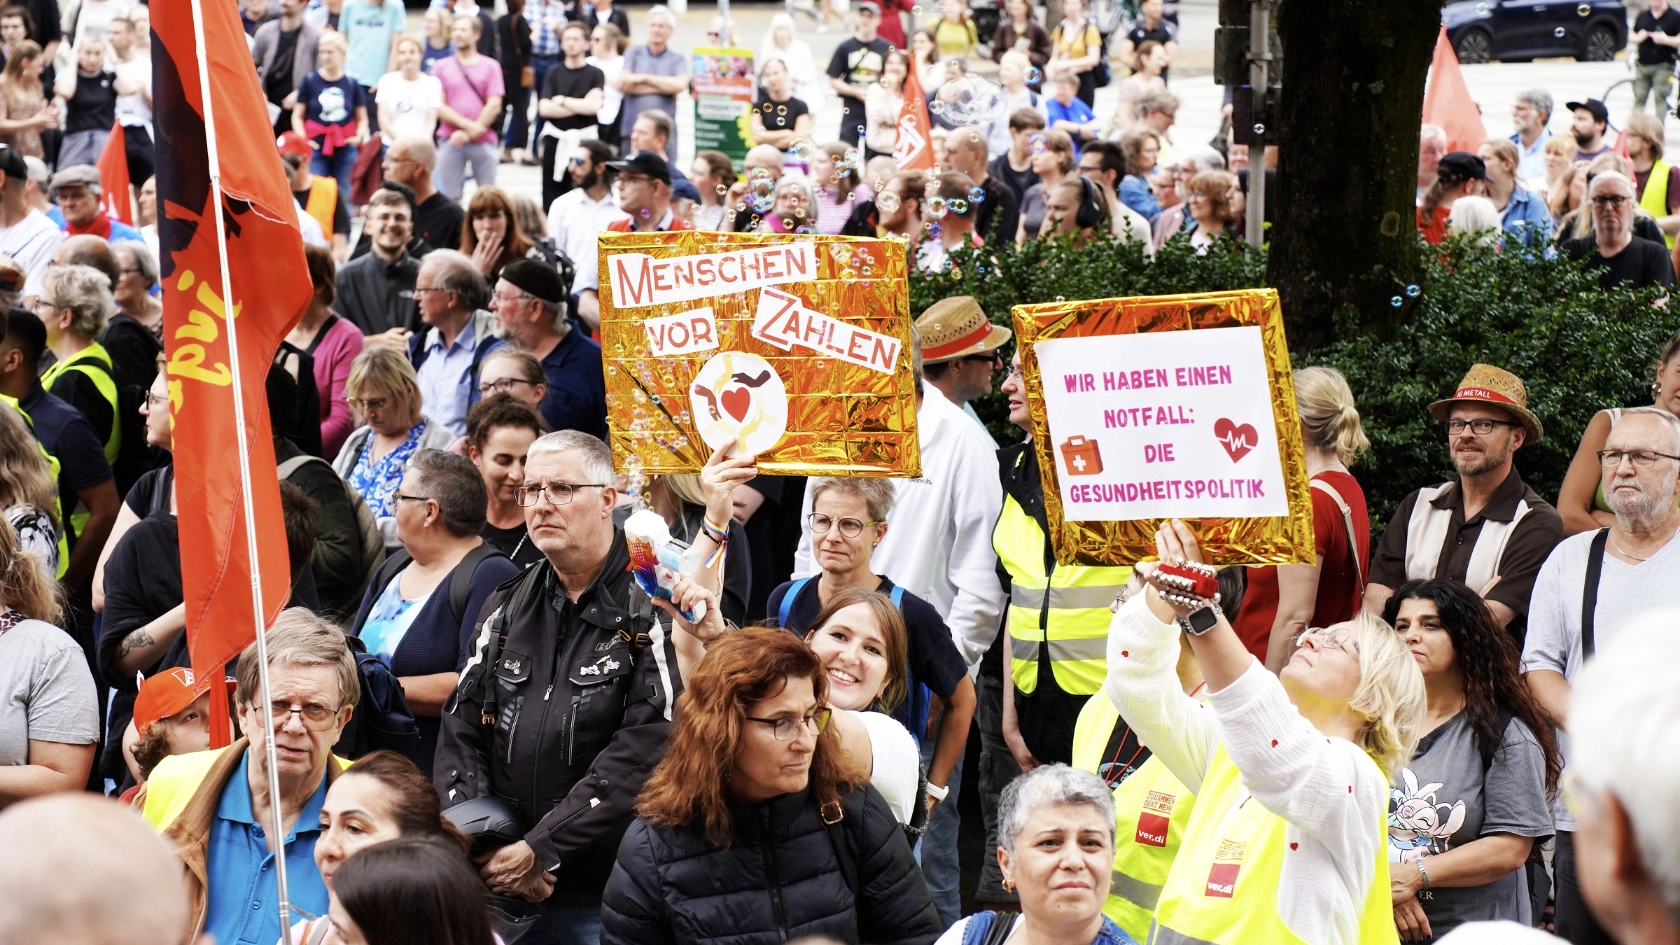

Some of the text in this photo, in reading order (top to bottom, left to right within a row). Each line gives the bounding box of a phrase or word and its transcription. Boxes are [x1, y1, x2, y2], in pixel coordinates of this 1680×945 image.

[648, 317, 712, 352] VOR
[1063, 365, 1232, 393] WIR HABEN EINEN
[1463, 389, 1491, 399] METALL
[1103, 405, 1195, 428] NOTFALL:
[1144, 443, 1175, 463] DIE
[1070, 479, 1265, 503] GESUNDHEITSPOLITIK
[1147, 792, 1175, 804] ZUSAMMEN
[1138, 829, 1165, 844] ver.di
[1207, 882, 1234, 894] ver.di
